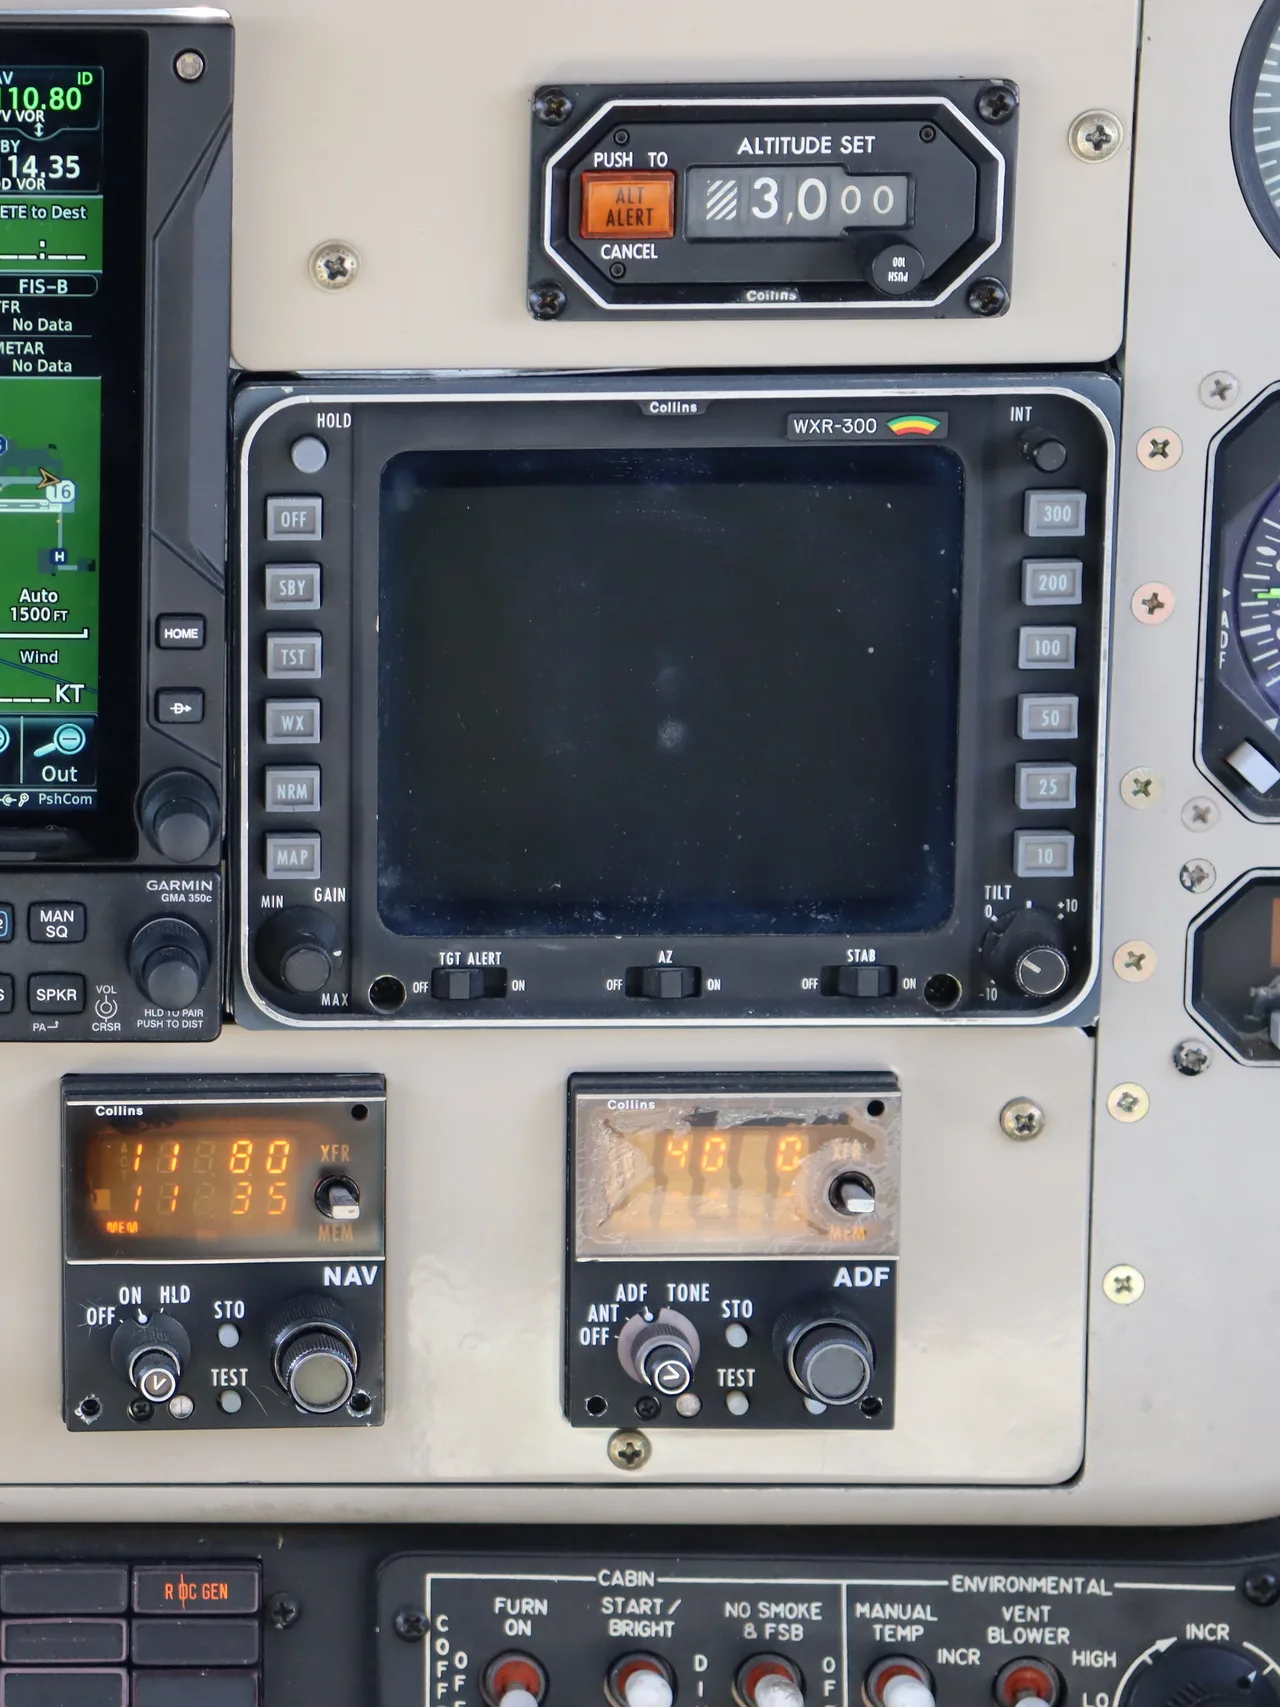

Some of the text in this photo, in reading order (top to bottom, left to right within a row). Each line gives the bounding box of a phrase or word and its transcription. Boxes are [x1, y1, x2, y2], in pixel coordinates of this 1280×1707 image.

[15, 109, 45, 123] VOR
[737, 136, 875, 155] ALTITUDE SET
[593, 152, 668, 167] PUSH TO
[16, 178, 46, 191] VOR
[616, 187, 644, 205] ALT
[606, 208, 653, 227] ALERT
[601, 244, 658, 260] CANCEL
[19, 279, 68, 294] FIS-B
[12, 318, 73, 332] No Data
[649, 401, 698, 414] Collins
[1010, 406, 1033, 421] INT
[317, 413, 352, 428] HOLD
[793, 418, 877, 434] WXR-300
[281, 512, 306, 527] OFF
[1043, 506, 1072, 522] 300
[280, 580, 306, 595] SBY
[1039, 575, 1068, 591] 200
[20, 650, 58, 664] Wind
[41, 765, 78, 782] Out
[277, 784, 308, 799] NRM
[147, 880, 213, 891] GARMIN
[984, 885, 1012, 900] TILT
[161, 893, 186, 903] GMA
[314, 888, 346, 902] GAIN
[40, 910, 74, 923] MAN
[439, 952, 502, 965] TGT ALERT
[847, 949, 876, 962] STAB
[36, 988, 77, 1002] SPKR
[96, 1106, 144, 1116] Collins
[324, 1266, 378, 1287] NAV
[833, 1266, 890, 1288] ADF
[160, 1286, 191, 1305] HLD
[667, 1283, 710, 1302] TONE
[588, 1304, 619, 1323] ANT
[211, 1369, 249, 1387] TEST
[598, 1570, 655, 1588] CABIN
[952, 1575, 1113, 1596] ENVIRONMENTAL
[494, 1598, 548, 1616] FURN
[725, 1602, 823, 1621] NO SMOKE
[855, 1603, 938, 1622] MANUAL
[1001, 1606, 1051, 1623] VENT
[608, 1618, 675, 1638] BRIGHT
[873, 1625, 924, 1643] TEMP
[988, 1627, 1070, 1646] BLOWER
[937, 1648, 981, 1665] INCR
[1072, 1650, 1117, 1667] HIGH
